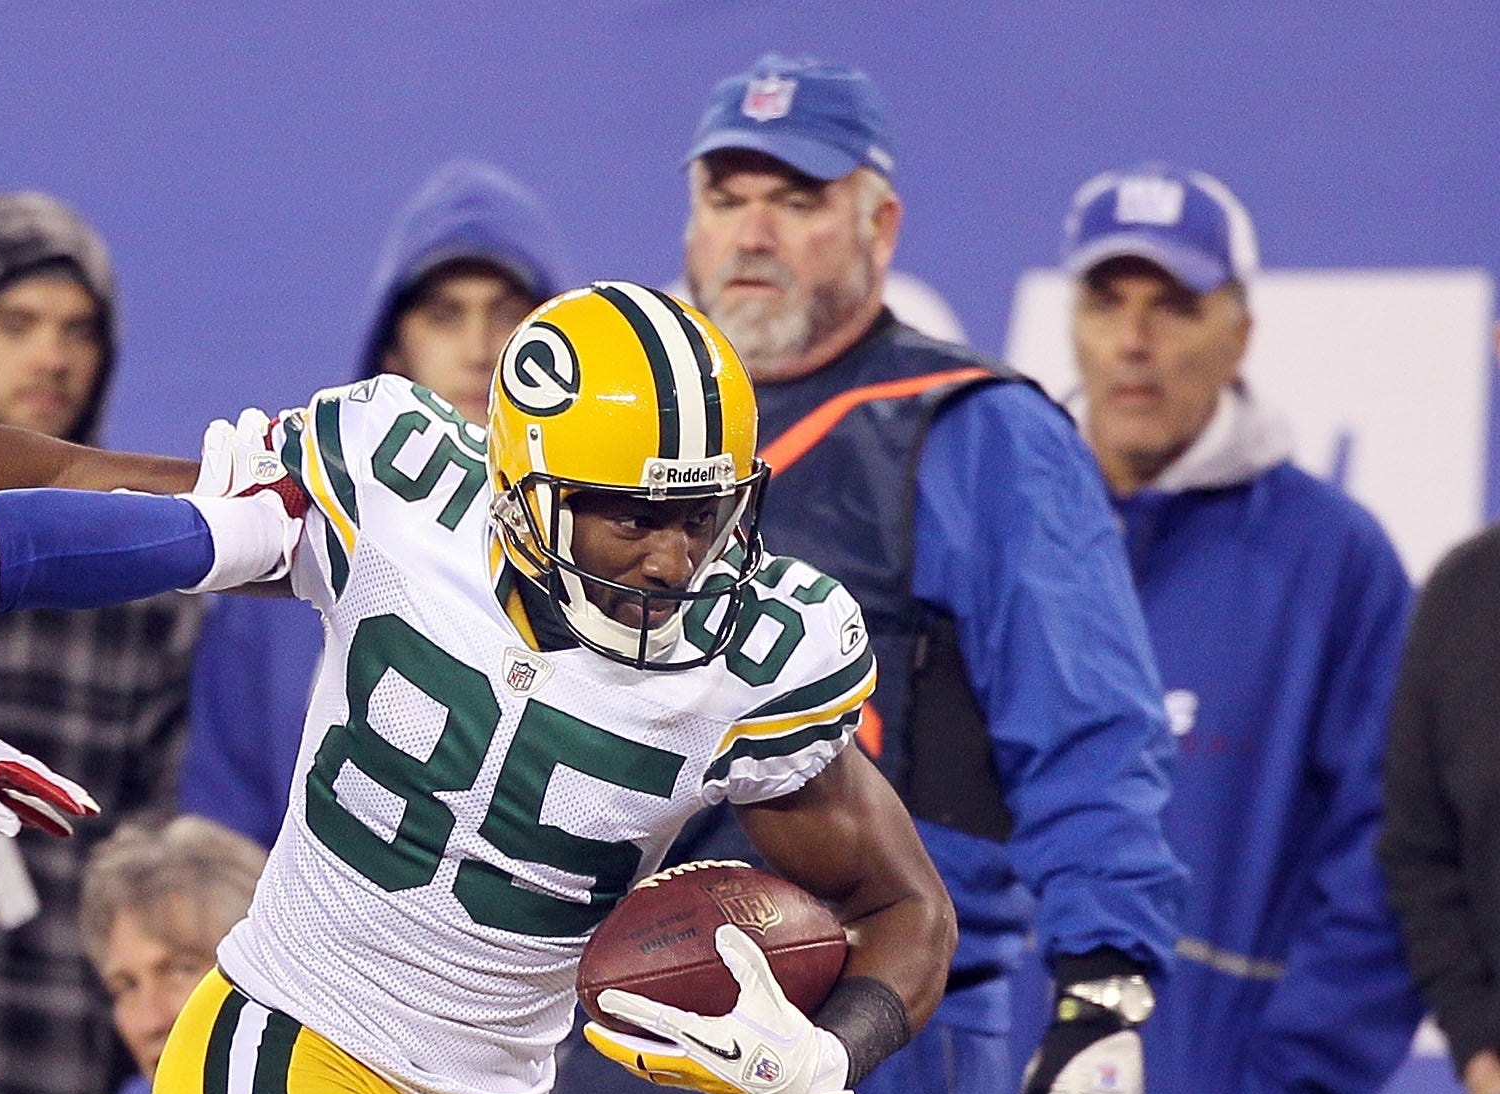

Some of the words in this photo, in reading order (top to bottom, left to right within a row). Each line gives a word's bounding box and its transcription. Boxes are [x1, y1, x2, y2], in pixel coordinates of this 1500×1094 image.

[501, 325, 578, 412] G
[666, 466, 717, 483] Riddell
[509, 671, 529, 689] NFL
[305, 612, 688, 938] 85
[722, 891, 779, 926] NFL
